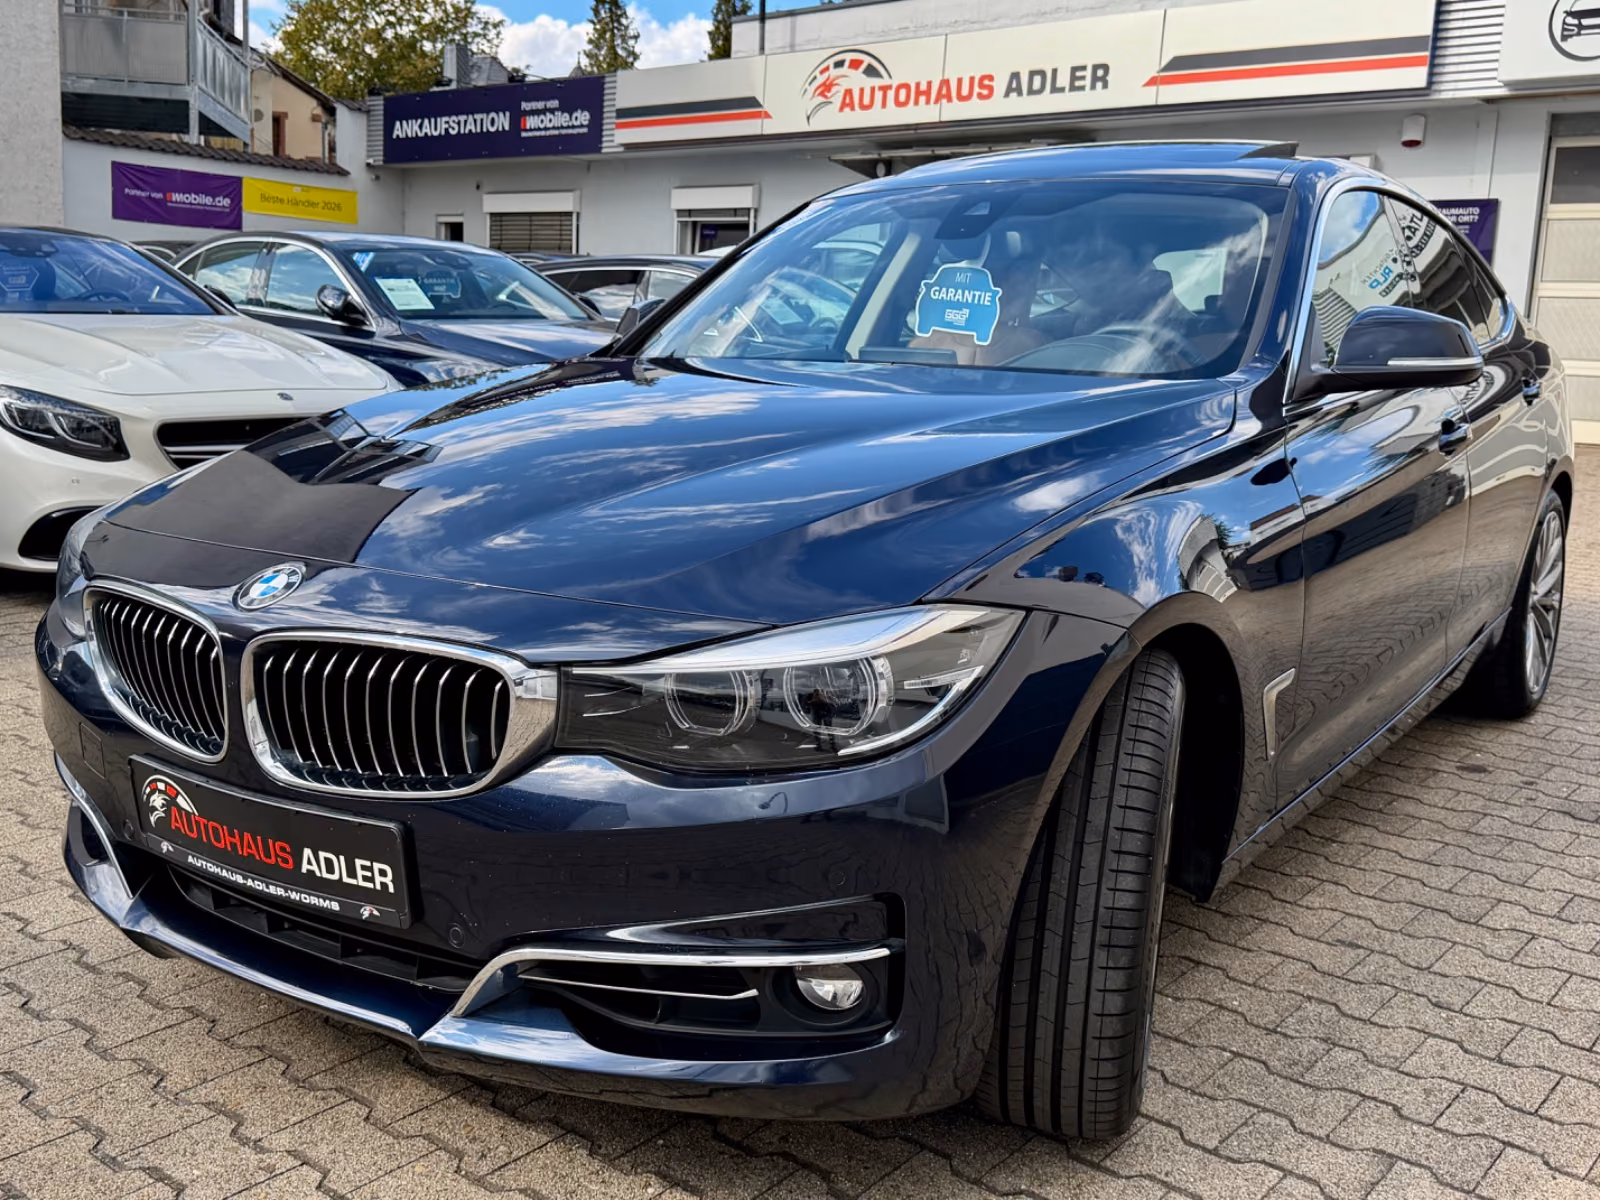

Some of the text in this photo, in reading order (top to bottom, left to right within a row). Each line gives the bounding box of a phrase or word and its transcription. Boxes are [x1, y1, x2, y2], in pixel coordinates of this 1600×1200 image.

[838, 63, 1111, 113] AUTOHAUS ADLER
[521, 99, 560, 111] Partner von
[392, 111, 511, 139] ANKAUFSTATION
[526, 108, 591, 129] mobile.de
[124, 188, 164, 199] Partner von
[171, 192, 231, 207] mobile.de
[260, 193, 343, 212] Beste Händler 2026
[955, 272, 972, 283] MIT
[930, 286, 993, 306] GARANTIE
[170, 806, 395, 893] AUTOHAUS ADLER
[187, 855, 340, 911] AUTOHAUS-ADLER-WORMS
